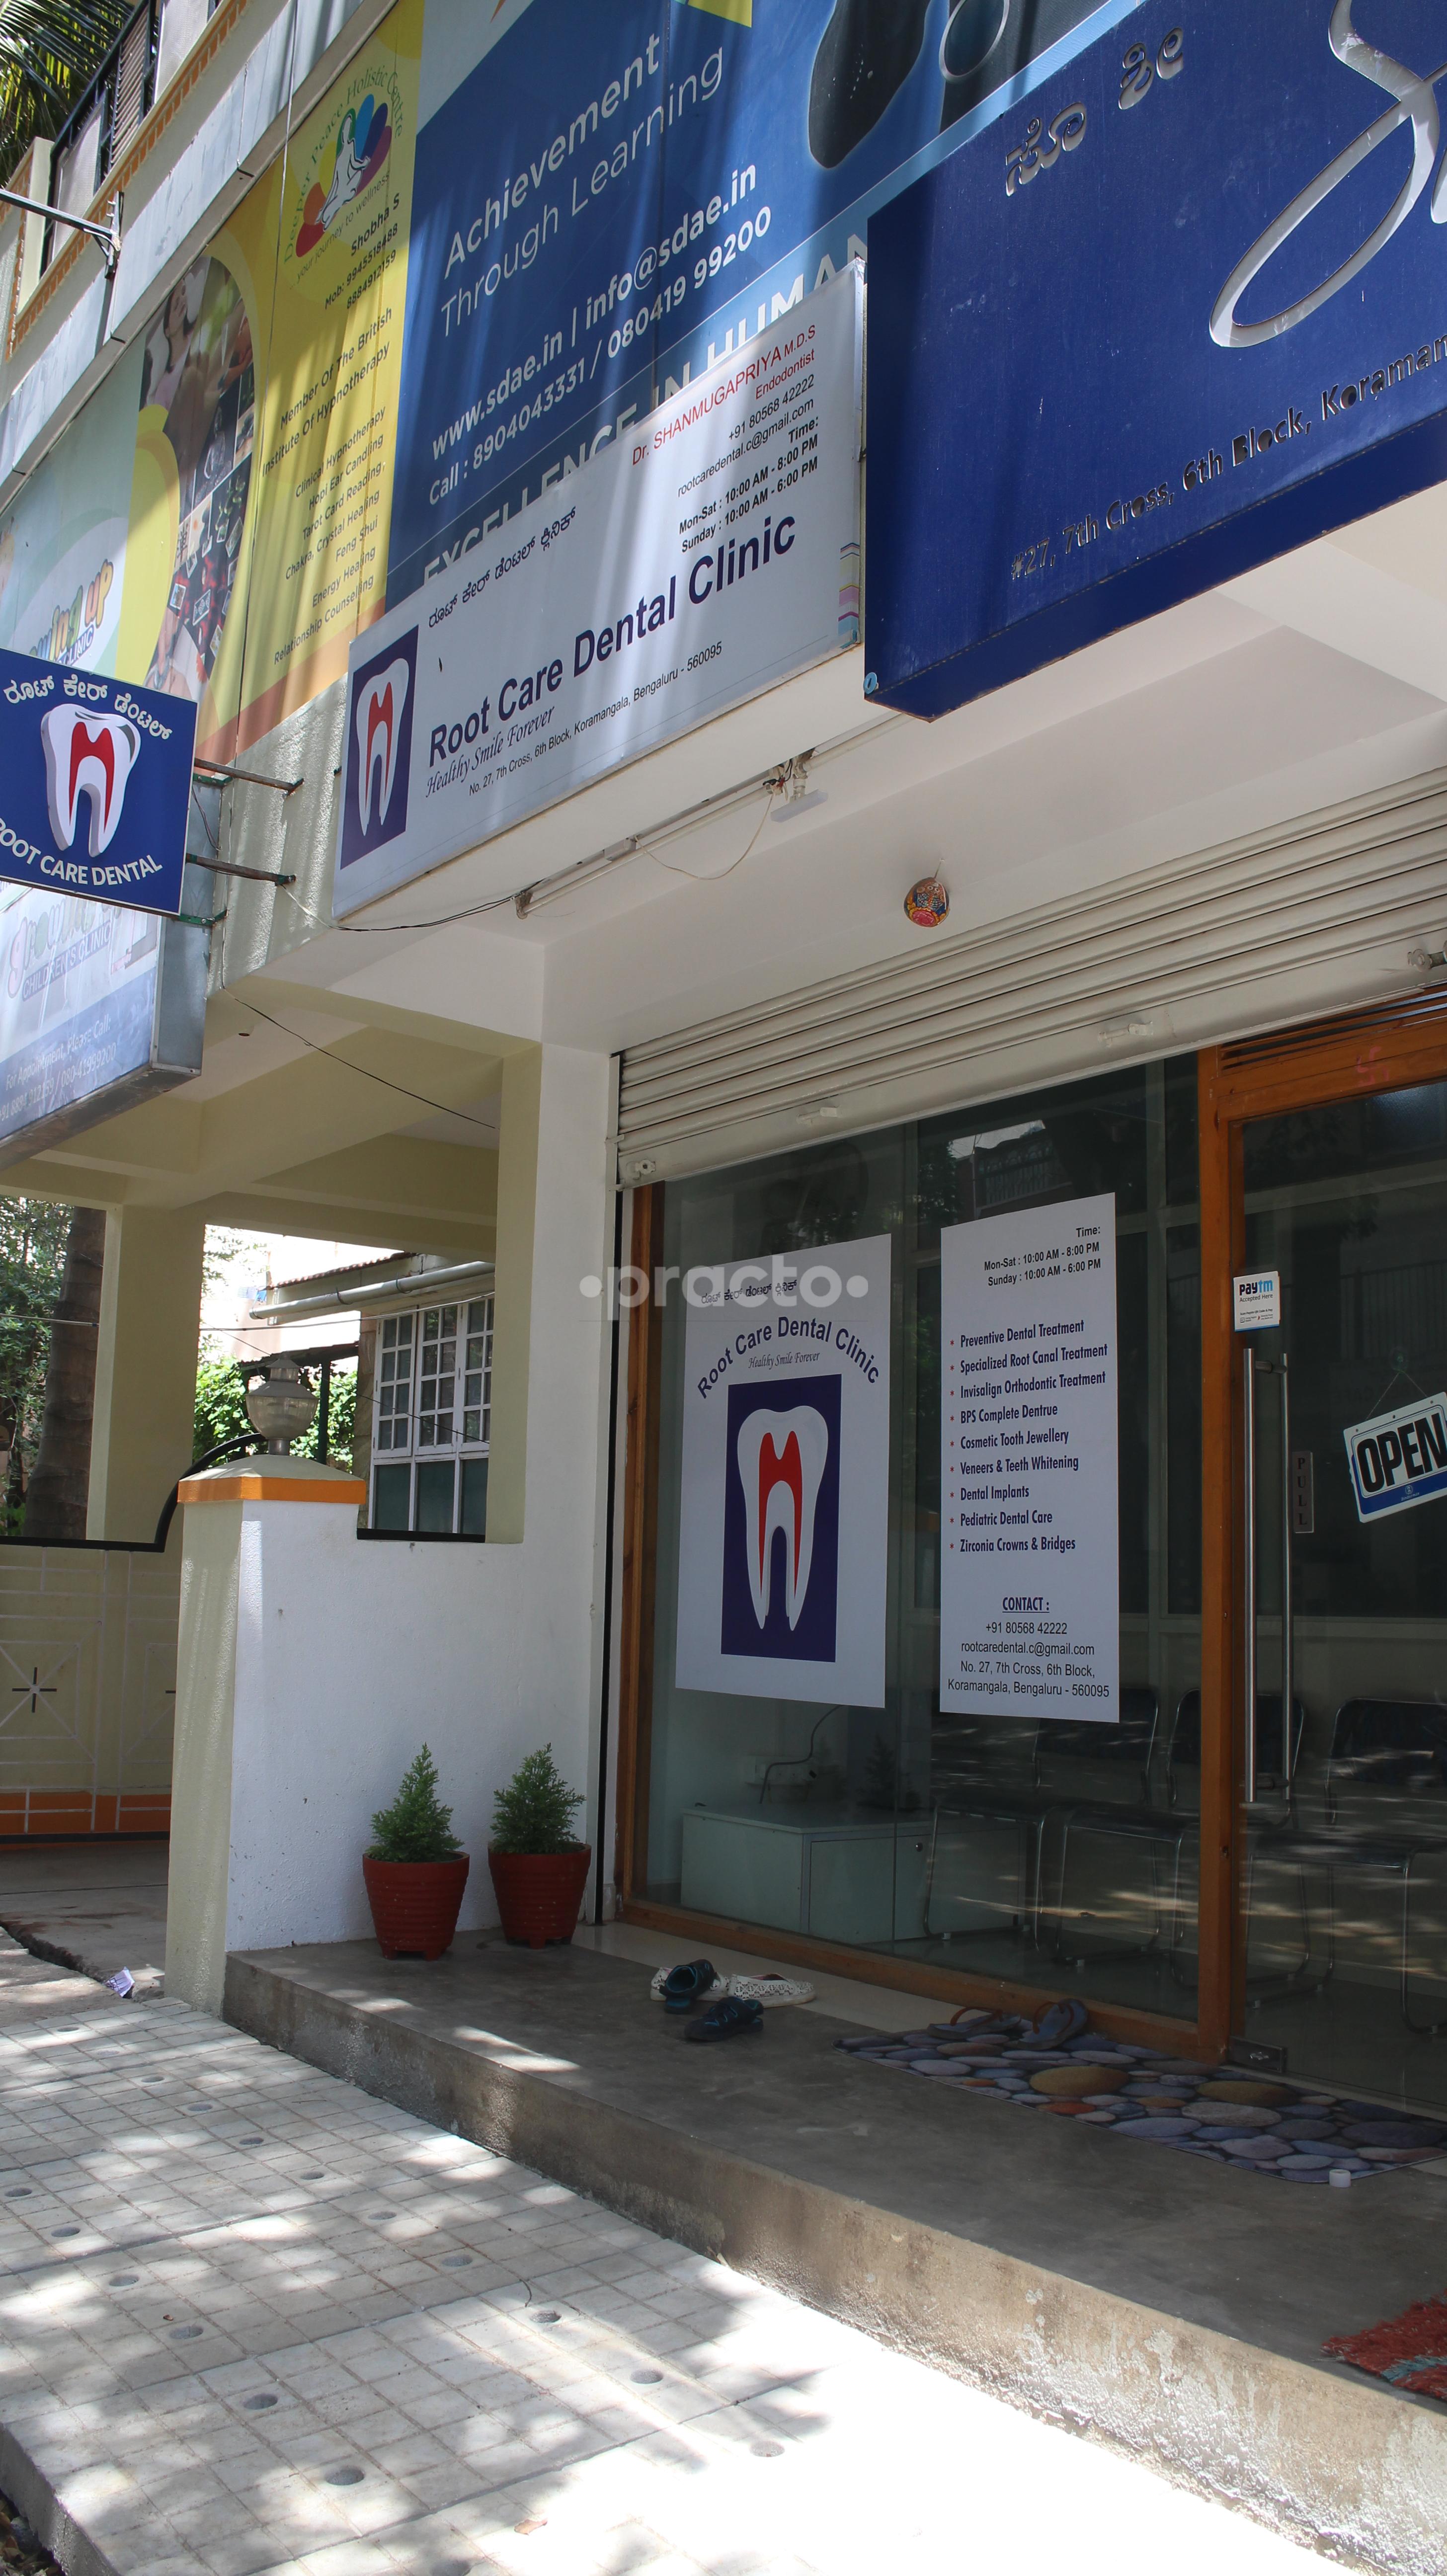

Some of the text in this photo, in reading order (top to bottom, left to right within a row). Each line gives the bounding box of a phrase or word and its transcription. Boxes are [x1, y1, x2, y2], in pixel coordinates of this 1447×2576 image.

[284, 172, 310, 263] Deeper
[311, 103, 343, 164] Peace
[347, 65, 388, 105] Holistic
[444, 33, 659, 280] Achievement
[356, 174, 390, 214] wellness
[441, 47, 723, 337] Through Learning
[346, 223, 398, 286] 9945518488
[351, 207, 389, 256] Shobha
[347, 249, 396, 309] 8884912159
[432, 164, 756, 461] www.sdae.in info@sdae.in
[473, 206, 771, 470] 8904043331 080419 99200
[280, 307, 392, 430] Member The British
[632, 324, 816, 466] Dr. SHANMUGAPRIYA M.D.S
[755, 348, 815, 400] Endodontist
[262, 341, 390, 477] Institute Hypnotherapy
[749, 374, 814, 429] 80568 42222
[788, 416, 819, 444] Time:
[296, 406, 386, 498] Clinical Hypnotherapy
[346, 434, 384, 476] Candling
[678, 399, 814, 497] rootcaredental.c@gmail.com
[325, 496, 344, 520] Card
[679, 433, 818, 535] Mon-Sat 10:00 AM 8:00 PM
[681, 456, 818, 554] Sunday 10:00 AM 6:00 PM
[1011, 537, 1056, 581] #27,
[1062, 514, 1100, 556] 7th
[1106, 481, 1175, 532] Cross,
[1183, 448, 1224, 492] 6th
[1232, 406, 1312, 468] Block,
[317, 489, 380, 553] Crystal Healing
[312, 546, 376, 609] Energy Healing
[335, 537, 357, 563] Feng
[428, 593, 457, 628] ರೂಟ್
[462, 569, 490, 604] ಕೇರ್
[494, 536, 536, 580] ಡೆಂಟಲ್
[274, 575, 374, 665] Relationship Counselling
[428, 516, 796, 768] Root Care Dental Clinic
[3, 673, 173, 740] ರೂಟ್ ಕೇರ್ ಡೆಂಟಲ್
[508, 641, 723, 773] Cross, 6th Block, Koramangala, Bengaluru 560095
[425, 705, 555, 798] Healthy Smile Forever
[40, 855, 88, 885] CARE
[91, 854, 163, 886] DENTAL
[6, 1074, 17, 1091] For
[67, 1029, 92, 1054] Please
[984, 1241, 1100, 1271] Mon-Sat 10:00 AM 8:00 PM
[1076, 1225, 1101, 1238] Time:
[988, 1258, 1101, 1286] Sunday 10:00 AM 6:00 PM
[697, 1316, 880, 1399] Root Care Dental Clinic
[748, 1351, 820, 1370] Healthy Smile Forever
[960, 1319, 1084, 1348] Preventive Dental Treatment
[960, 1343, 1108, 1375] Specialized Root Canal Treatment
[960, 1371, 1106, 1399] Invisalign Orthodontic Treatment
[960, 1404, 1058, 1424] BPS Complete Dentrue
[960, 1428, 1069, 1449] Cosmetic Tooth Jewellery
[960, 1455, 1079, 1475] Veneers Teeth Whitening
[1357, 1412, 1447, 1493] OPEN
[960, 1484, 1029, 1502] Dental Implants
[960, 1510, 1052, 1527] Pediatric Dental Care
[1298, 1457, 1307, 1526] PULL
[960, 1535, 1076, 1553] Zirconia Crowns Bridges
[986, 1621, 1067, 1635] +91 80568 42222
[1002, 1597, 1043, 1611] CONTACT
[961, 1641, 1094, 1657] rootcaredental.c@gmail.com
[961, 1660, 1095, 1679] No. 27, 7th Cross, 6th Block,
[948, 1679, 1110, 1697] Koramangala, Bengaluru 560095
